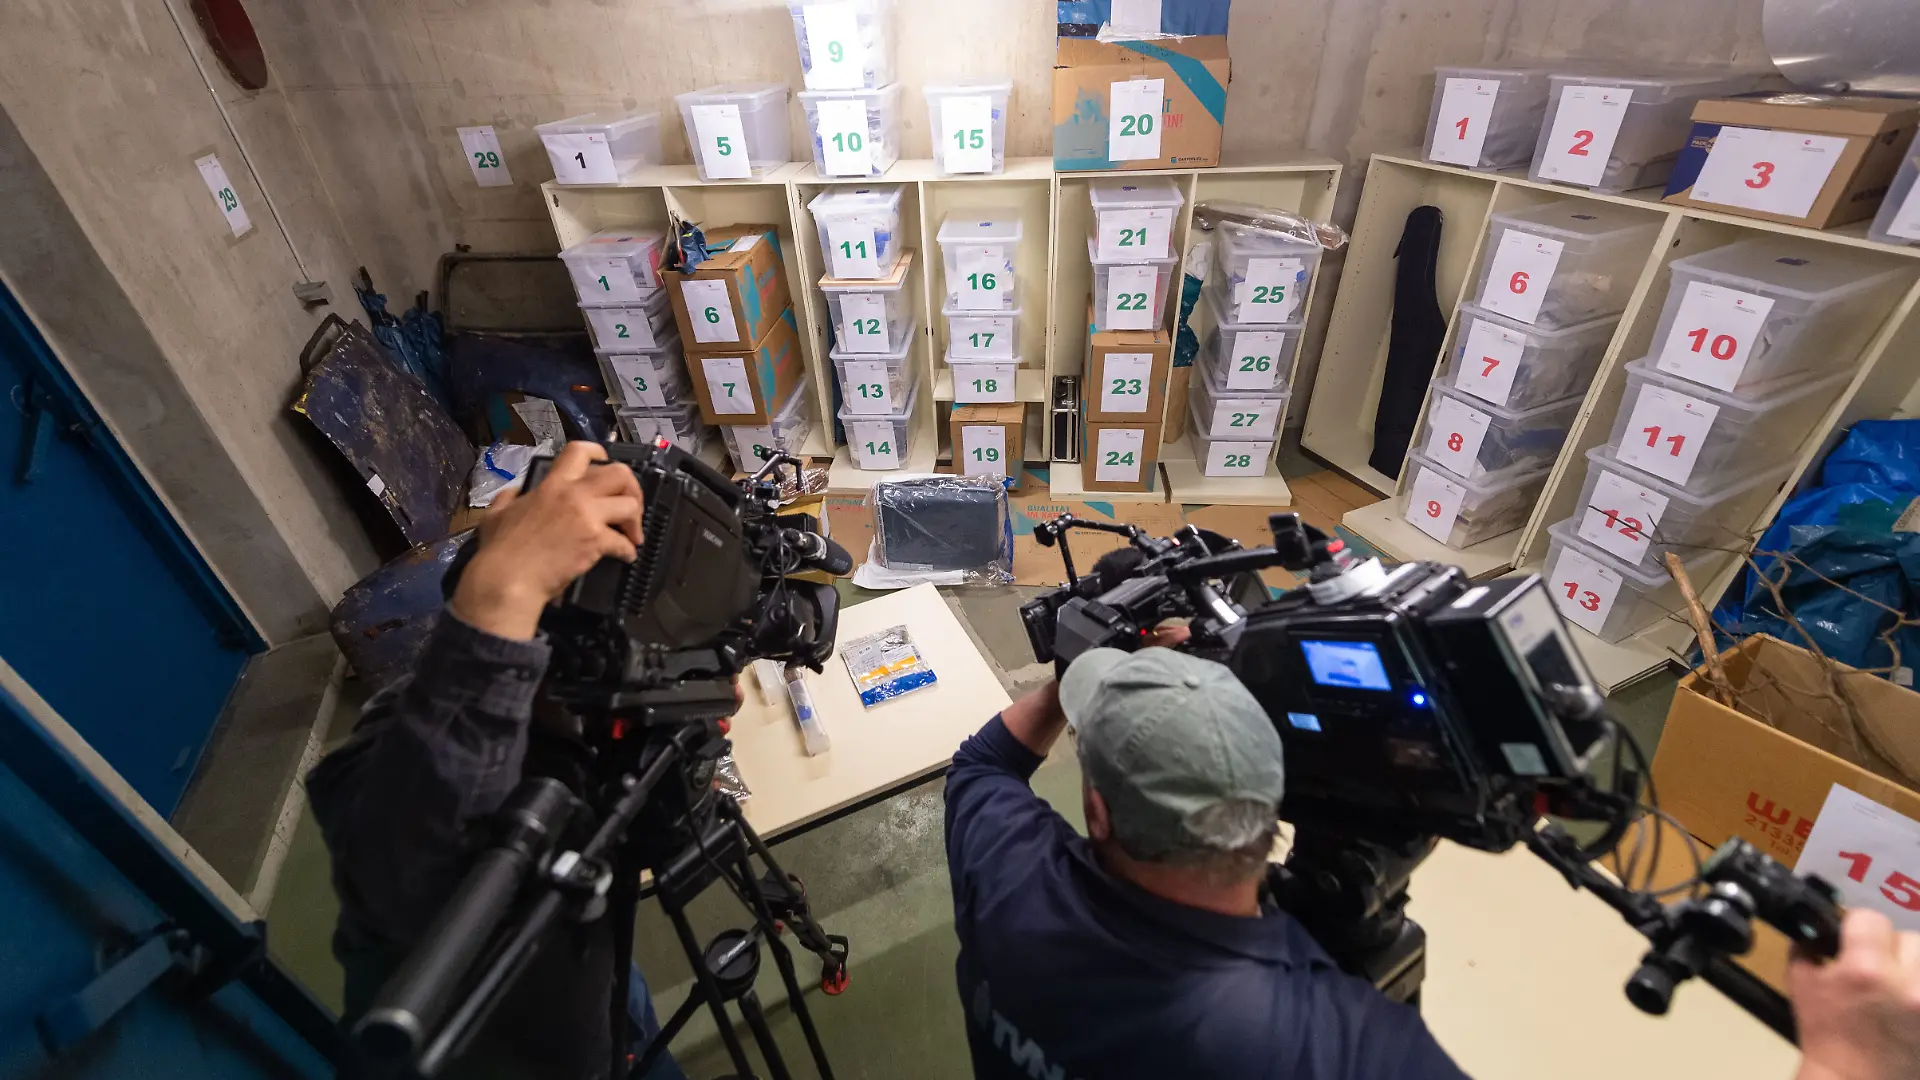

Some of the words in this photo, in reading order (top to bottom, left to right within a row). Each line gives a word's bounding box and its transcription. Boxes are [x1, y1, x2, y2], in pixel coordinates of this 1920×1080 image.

[827, 39, 844, 64] 9
[1119, 113, 1154, 137] 20
[1455, 117, 1470, 140] 1
[716, 136, 732, 156] 5
[832, 132, 862, 153] 10
[953, 128, 984, 150] 15
[1567, 129, 1594, 157] 2
[474, 151, 500, 169] 29
[574, 152, 587, 169] 1
[1744, 161, 1775, 189] 3
[219, 187, 238, 212] 29
[1118, 227, 1147, 247] 21
[840, 240, 867, 259] 11
[598, 275, 611, 292] 1
[967, 273, 996, 291] 16
[1509, 271, 1530, 295] 6
[1116, 292, 1148, 311] 22
[1251, 285, 1286, 304] 25
[704, 306, 720, 324] 6
[615, 323, 630, 339] 2
[852, 318, 881, 335] 12
[968, 332, 995, 348] 17
[1687, 327, 1738, 361] 10
[1238, 355, 1271, 372] 26
[1481, 356, 1501, 378] 7
[633, 376, 648, 392] 3
[722, 382, 736, 398] 7
[857, 383, 884, 399] 13
[972, 378, 998, 393] 18
[1111, 378, 1142, 395] 23
[1229, 412, 1260, 427] 27
[865, 441, 892, 455] 14
[1447, 432, 1464, 452] 8
[1643, 426, 1686, 457] 11
[972, 447, 999, 462] 19
[1105, 451, 1135, 466] 24
[1223, 454, 1251, 468] 28
[1426, 500, 1442, 519] 9
[1603, 509, 1643, 542] 12
[1563, 582, 1601, 612] 13
[1838, 850, 1920, 912] 15
